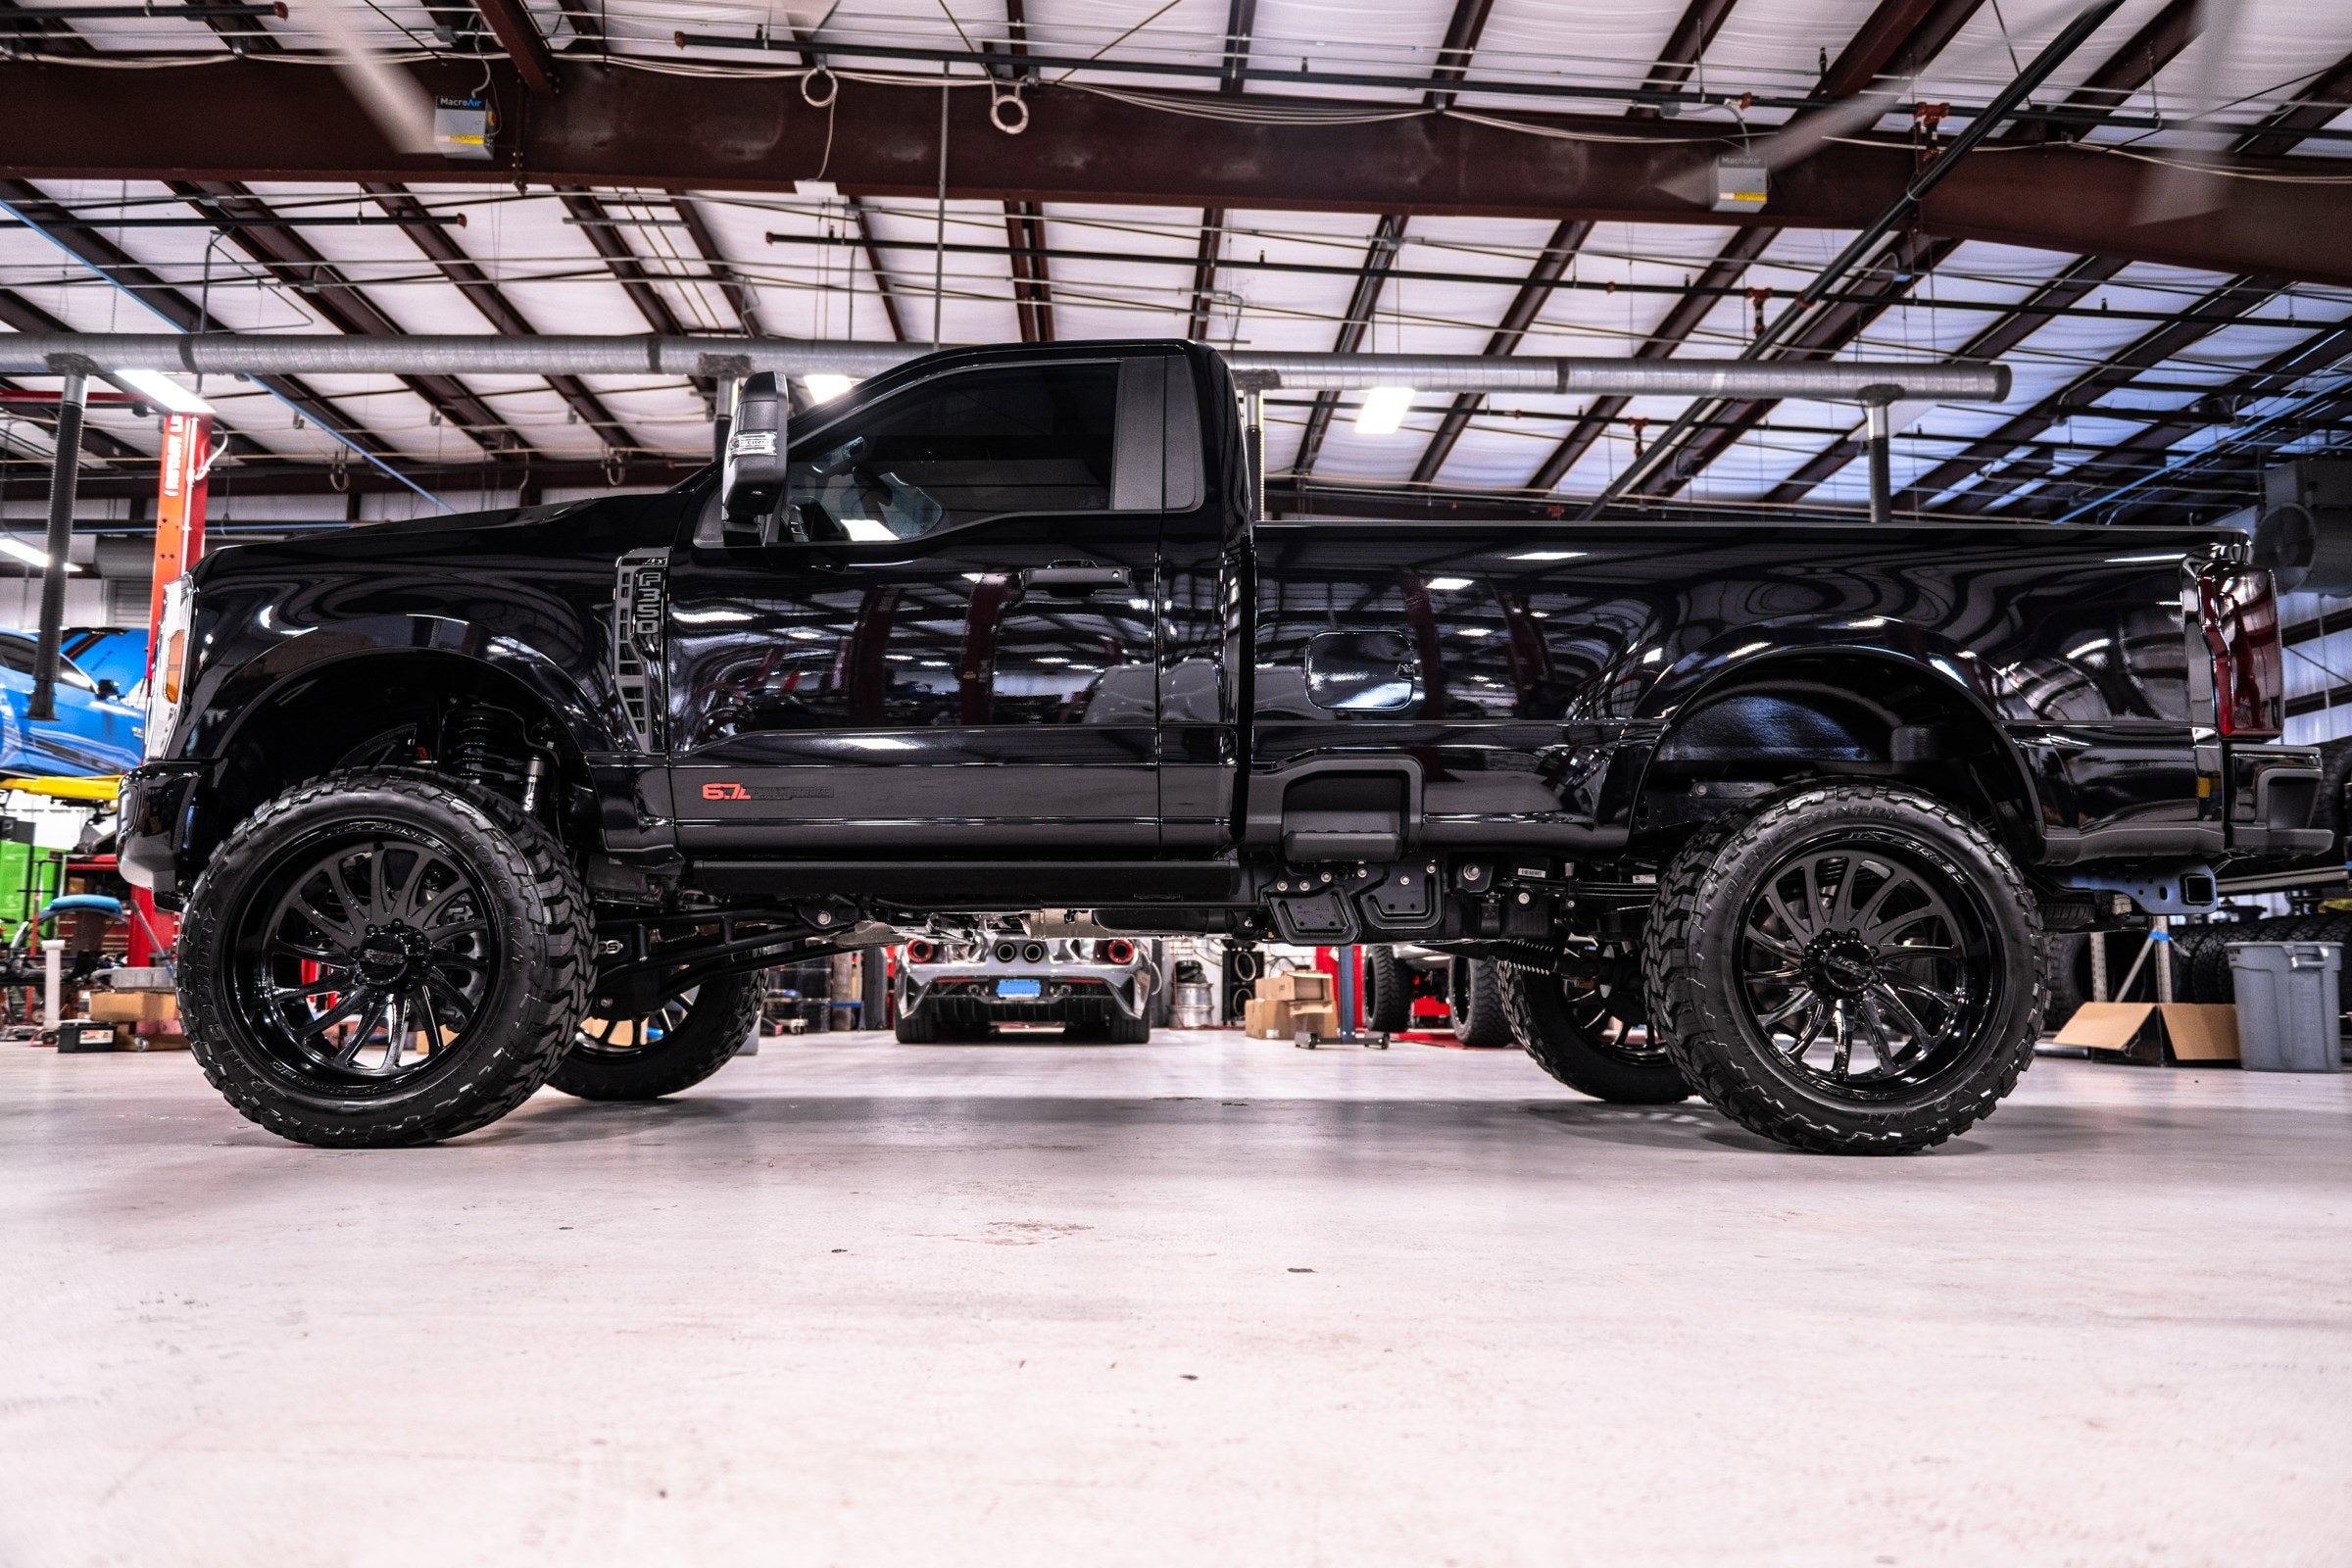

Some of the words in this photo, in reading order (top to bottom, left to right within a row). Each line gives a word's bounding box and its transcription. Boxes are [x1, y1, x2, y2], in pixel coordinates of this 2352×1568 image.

[440, 97, 482, 107] MacroAir
[702, 783, 752, 801] 6.7L
[1723, 837, 1776, 901] OPEN
[1779, 806, 1907, 834] COUNTRY
[461, 830, 514, 900] TOYO
[598, 942, 618, 952] DS
